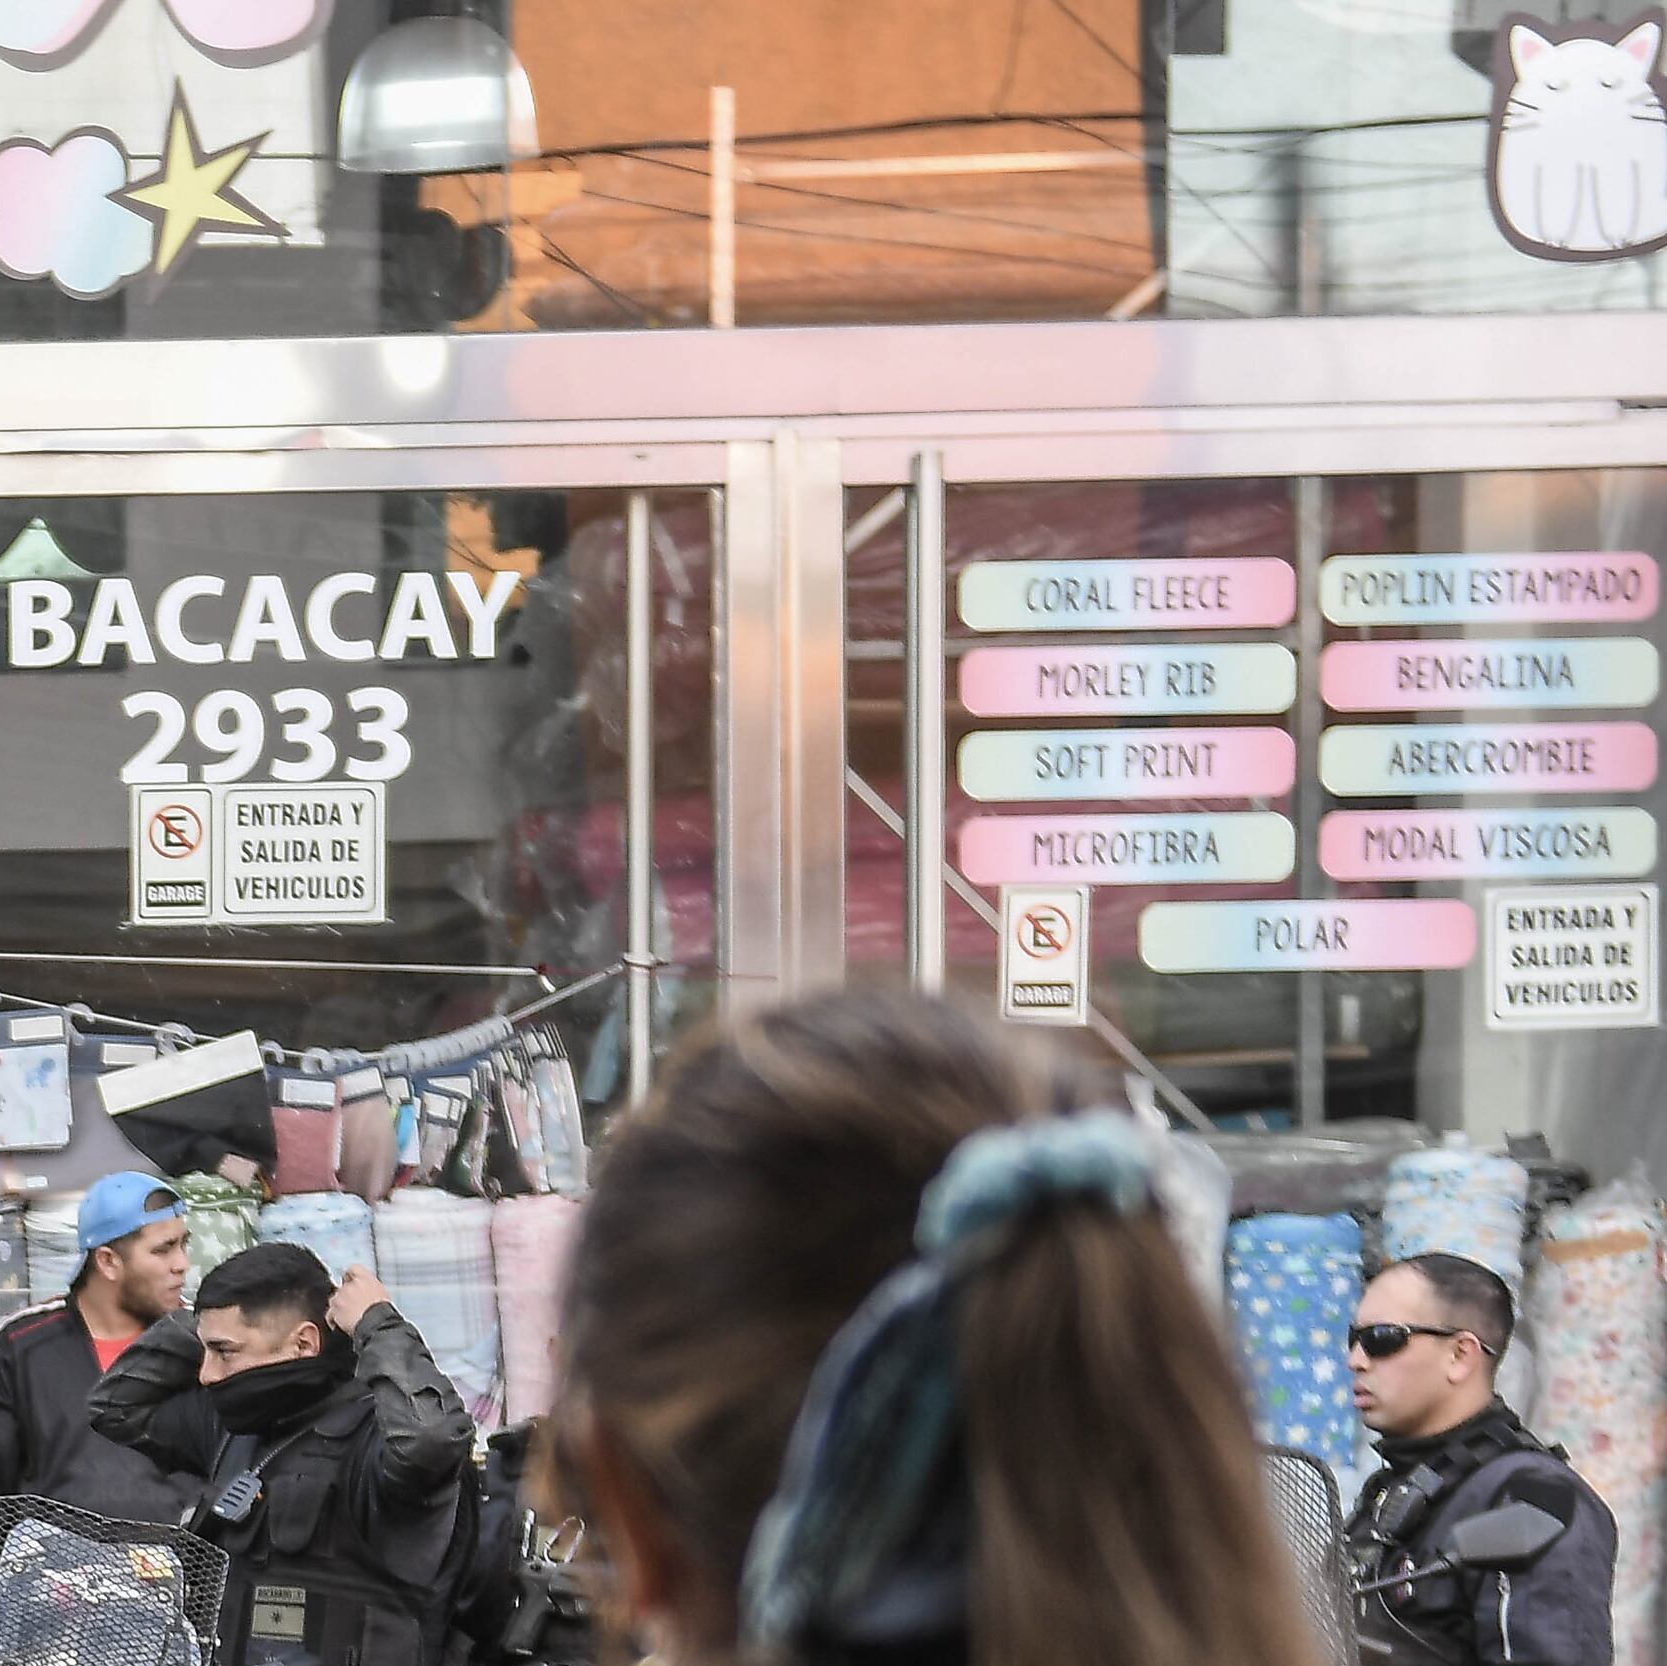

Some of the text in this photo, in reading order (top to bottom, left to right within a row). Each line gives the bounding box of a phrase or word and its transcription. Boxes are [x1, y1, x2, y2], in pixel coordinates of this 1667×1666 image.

[1026, 575, 1230, 613] CORAL FLEECE
[1343, 567, 1643, 606] POPLIN ESTAMPADO
[7, 571, 521, 668] BACACAY
[1038, 661, 1218, 699] MORLEY RIB
[1396, 654, 1575, 691] BENGALINA
[119, 686, 413, 785] 2933
[1034, 743, 1218, 780] SOFT PRINT
[1388, 738, 1595, 776] ABERCROMBIE
[236, 802, 364, 827] ENTRADA Y
[240, 839, 359, 864] SALIDA DE
[1032, 829, 1221, 867] MICROFIBRA
[1363, 823, 1613, 862] MODAL VISCOSA
[147, 884, 206, 902] GARAGE
[234, 875, 366, 900] VEHICULOS
[1256, 916, 1350, 952] POLAR
[1506, 906, 1637, 930] ENTRADA Y
[1510, 942, 1632, 968] SALIDA DE
[1505, 979, 1638, 1005] VEHICULOS
